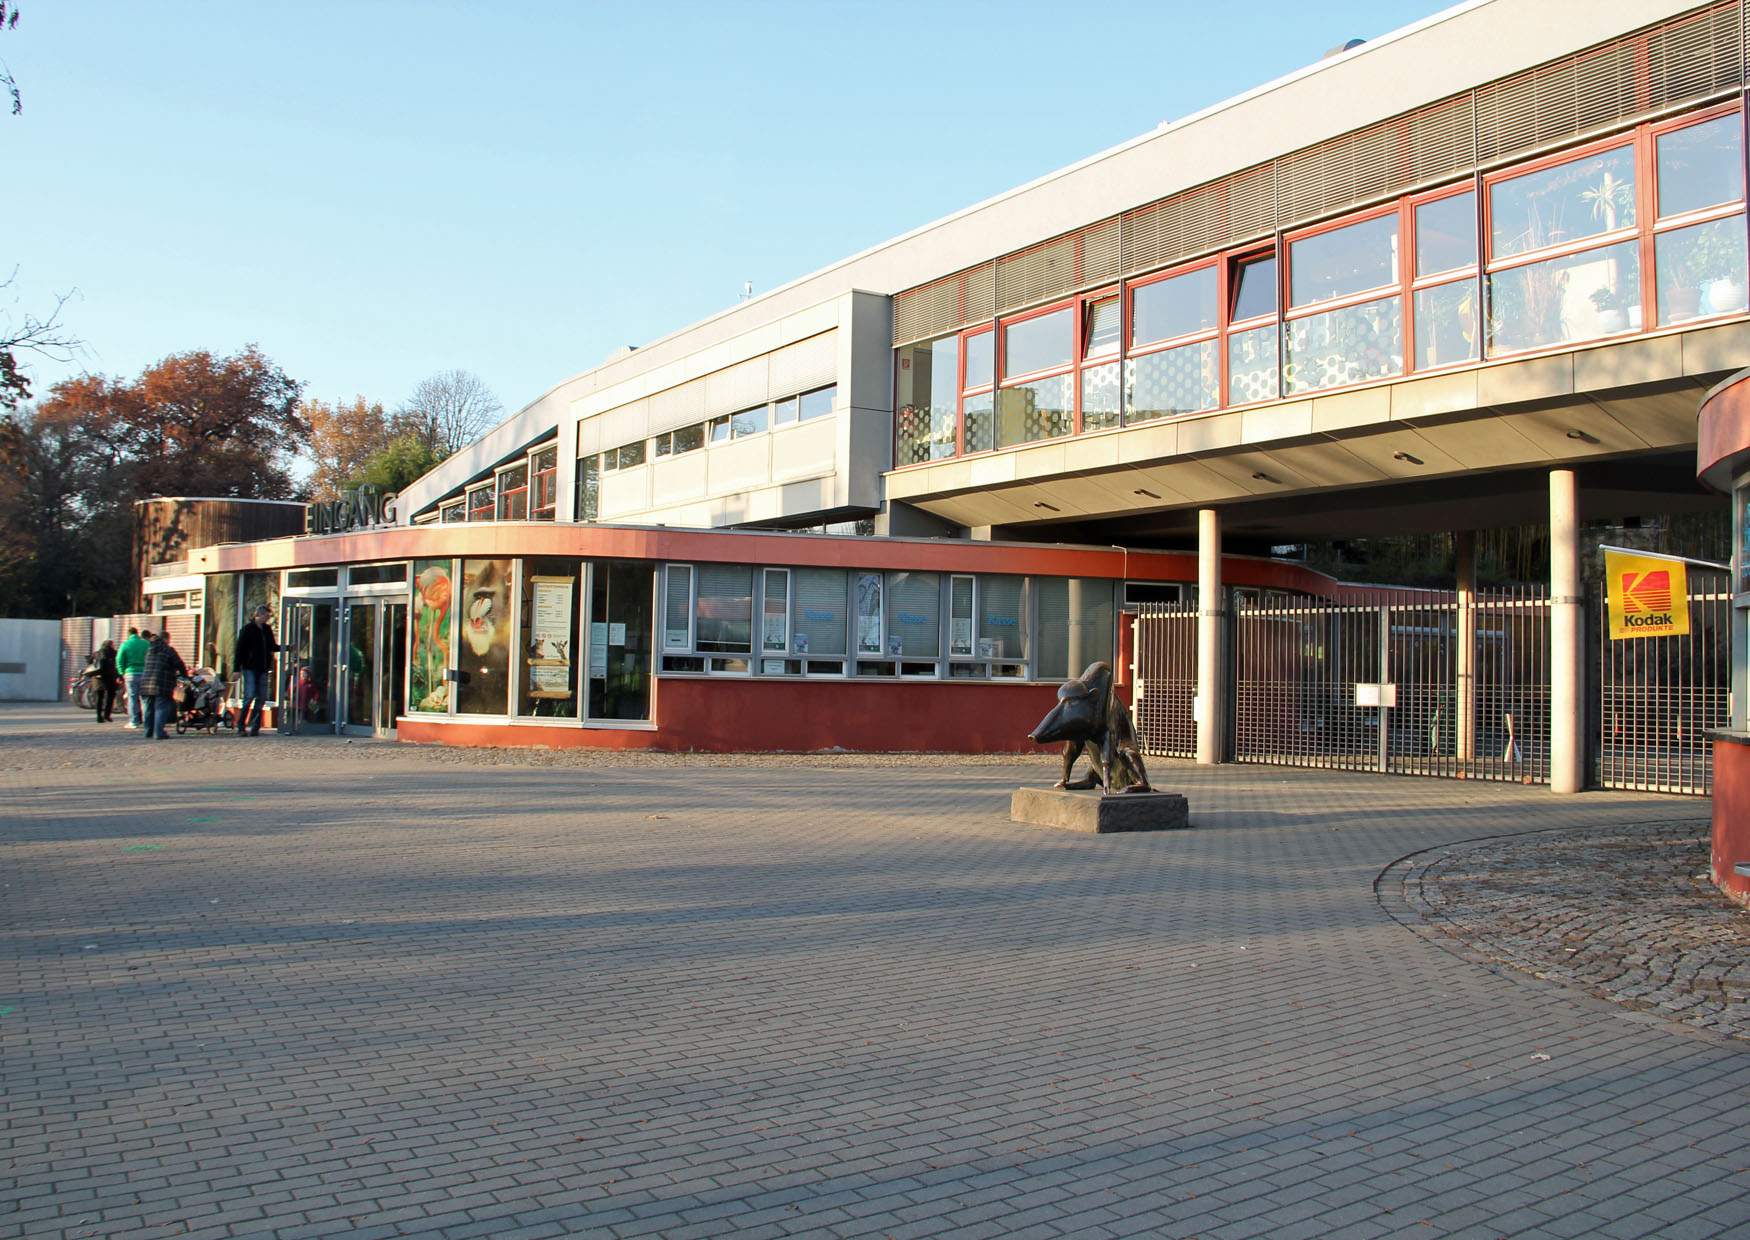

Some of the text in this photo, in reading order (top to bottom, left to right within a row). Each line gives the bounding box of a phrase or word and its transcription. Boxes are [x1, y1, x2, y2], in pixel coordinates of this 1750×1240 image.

[304, 493, 397, 534] EINGANG
[1624, 613, 1673, 627] Kodak
[1631, 625, 1674, 633] PRODUKTE
